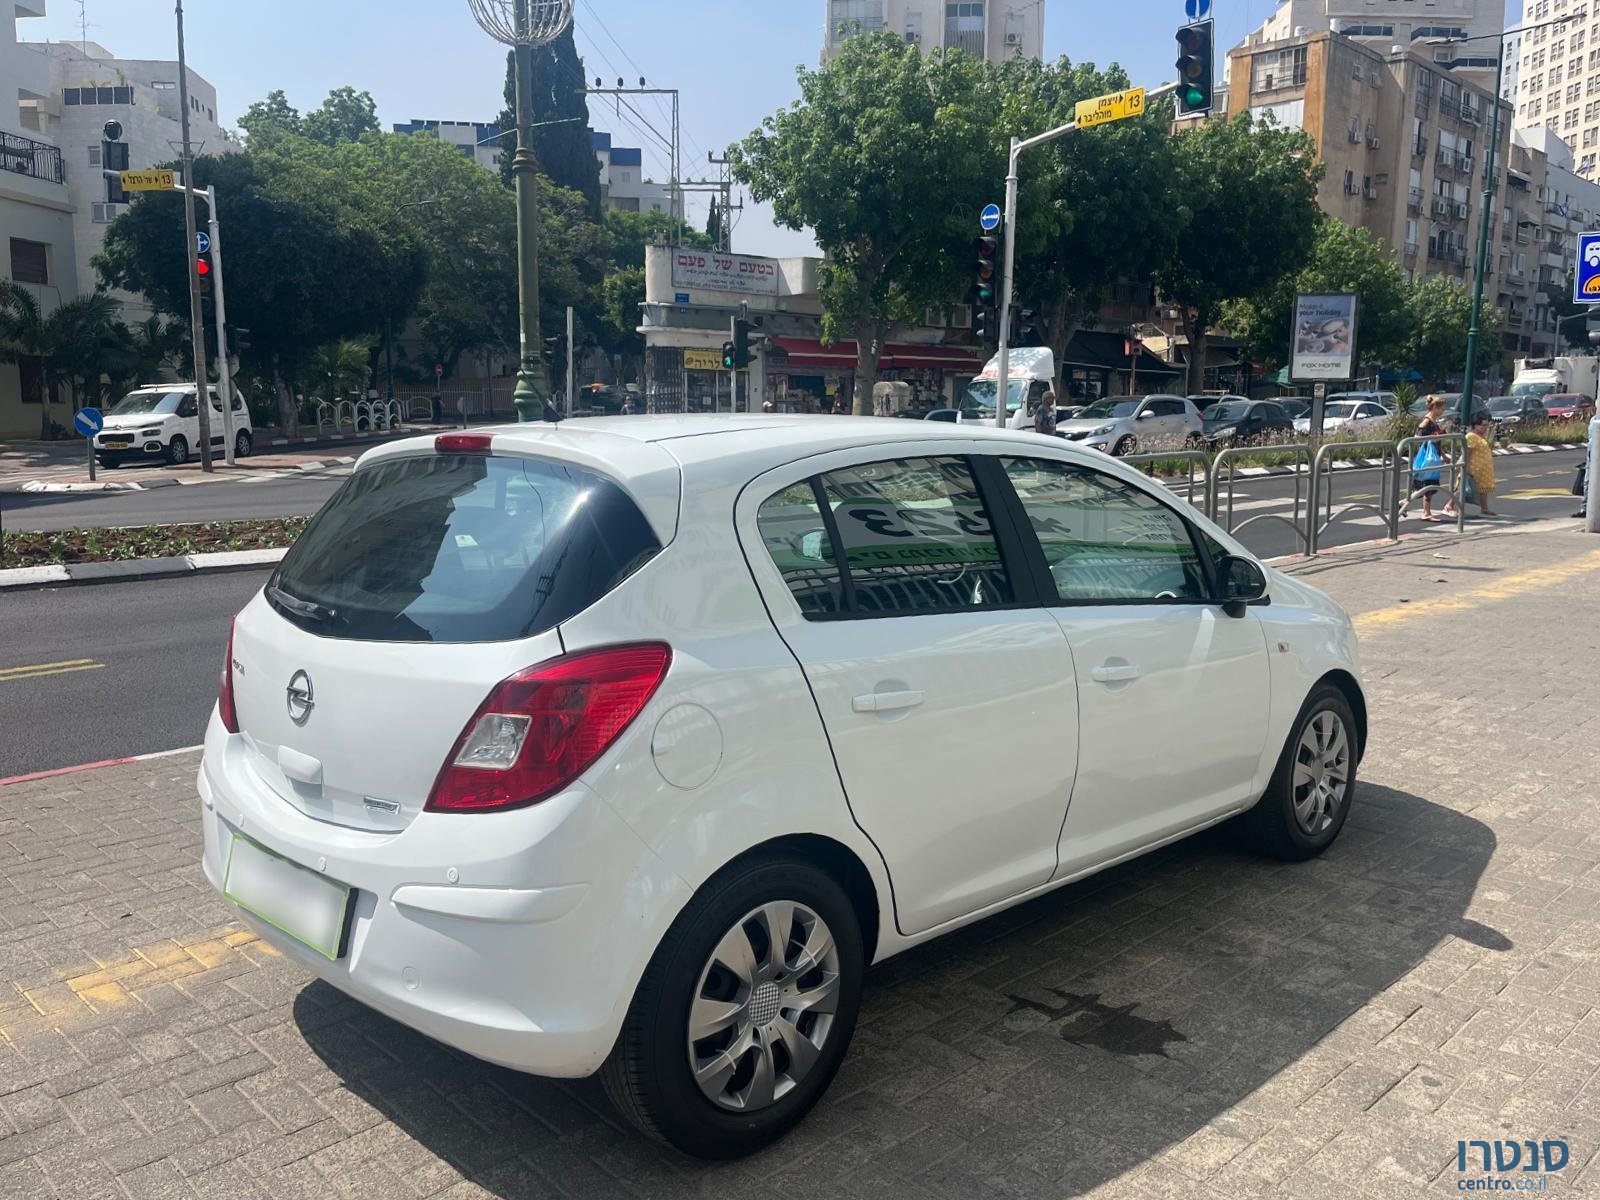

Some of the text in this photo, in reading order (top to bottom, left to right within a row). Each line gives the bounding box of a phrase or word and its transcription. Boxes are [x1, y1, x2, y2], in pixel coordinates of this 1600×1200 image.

[1098, 96, 1117, 109] ויצמן
[1129, 95, 1140, 108] 13
[1084, 109, 1112, 122] מוהליבר
[162, 174, 171, 184] 13
[678, 255, 705, 267] פעם
[713, 256, 733, 270] של
